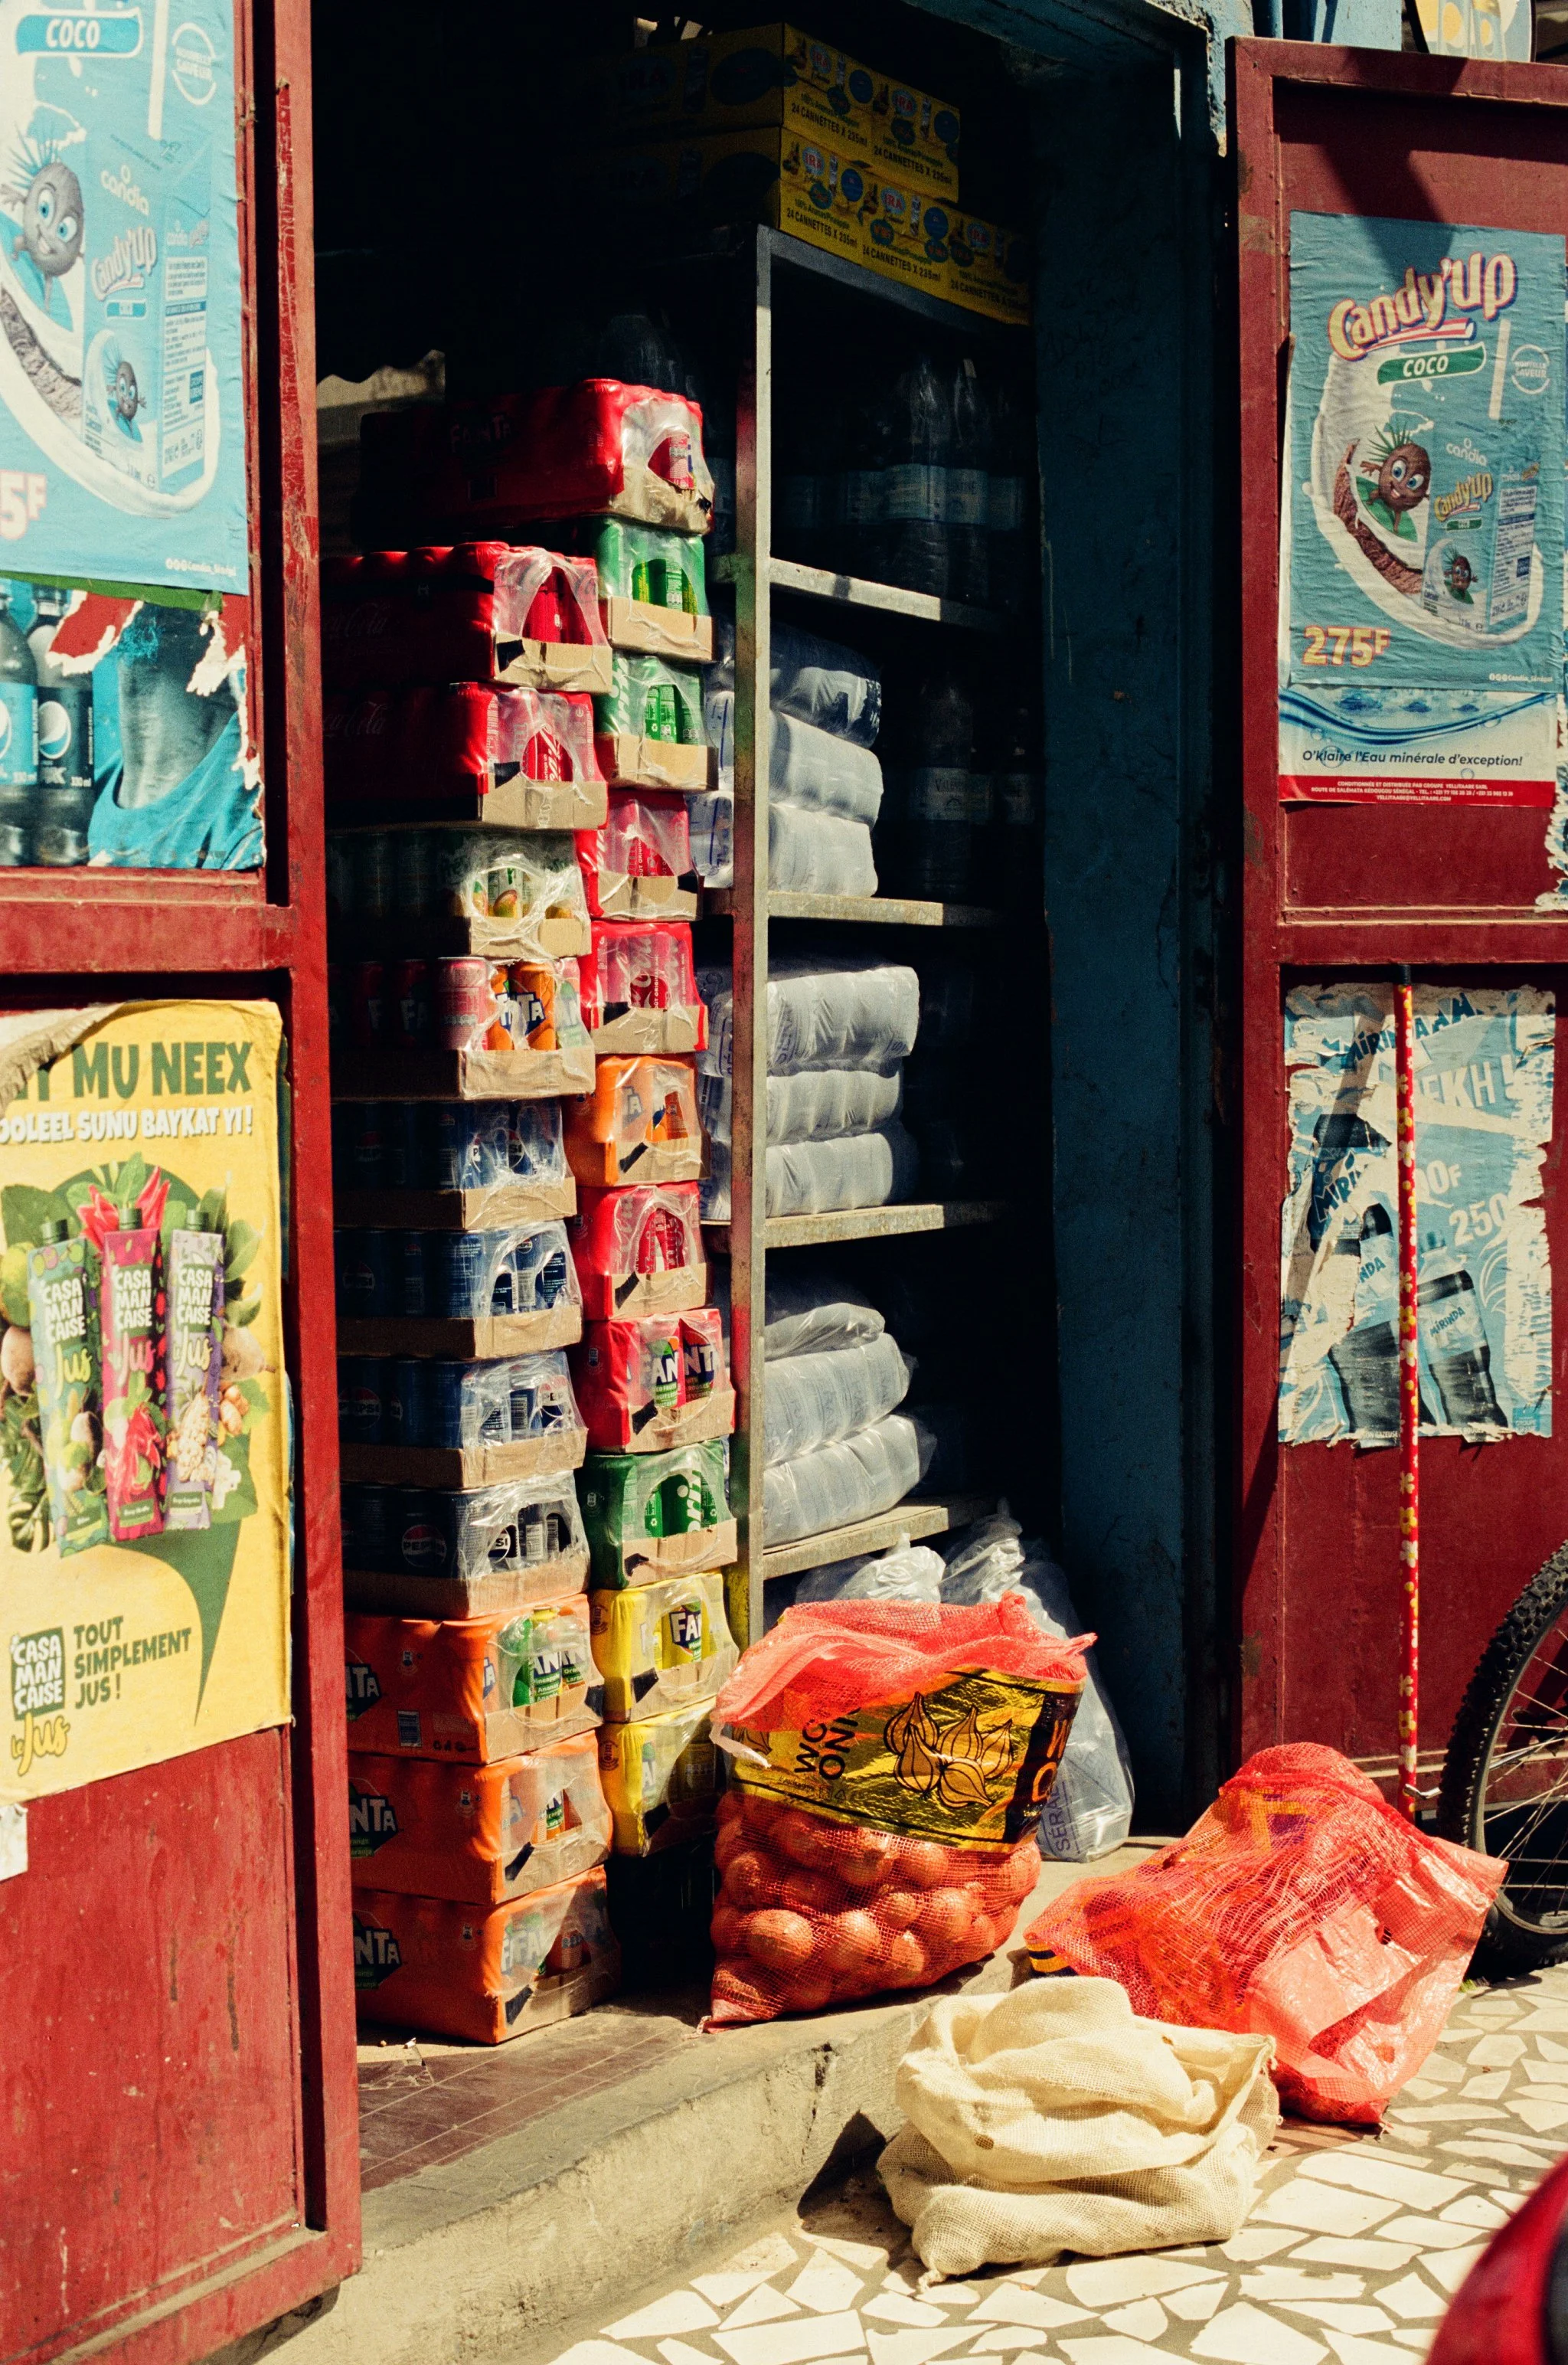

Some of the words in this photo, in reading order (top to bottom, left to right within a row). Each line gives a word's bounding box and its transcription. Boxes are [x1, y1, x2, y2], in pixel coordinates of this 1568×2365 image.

[46, 19, 101, 49] COCO
[1327, 251, 1520, 362] Candy'Up
[1402, 356, 1449, 378] COCO
[1446, 440, 1488, 466] candia
[1432, 471, 1494, 523] Candy'Up
[1302, 625, 1392, 667] 275F
[1302, 750, 1352, 762] O'klaire
[1354, 752, 1386, 763] l'Eau
[1389, 752, 1446, 764] minérale
[1448, 753, 1524, 767] d'exception!
[71, 1041, 140, 1100] MU
[151, 1041, 253, 1097] NEEX
[77, 1107, 139, 1142] SUNU
[141, 1107, 220, 1140] BAYKAT
[41, 1277, 83, 1304] CASA
[115, 1269, 150, 1290] CASA
[177, 1268, 213, 1289] CASA
[44, 1297, 83, 1323] MAN
[116, 1288, 152, 1308] MAN
[178, 1287, 213, 1307] MAN
[74, 1615, 124, 1650] TOUT
[11, 1634, 62, 1666] CASA
[74, 1627, 192, 1680] SIMPLEMENT
[15, 1657, 62, 1691] MAN
[75, 1676, 112, 1709] JUS
[18, 1712, 71, 1777] Jus
